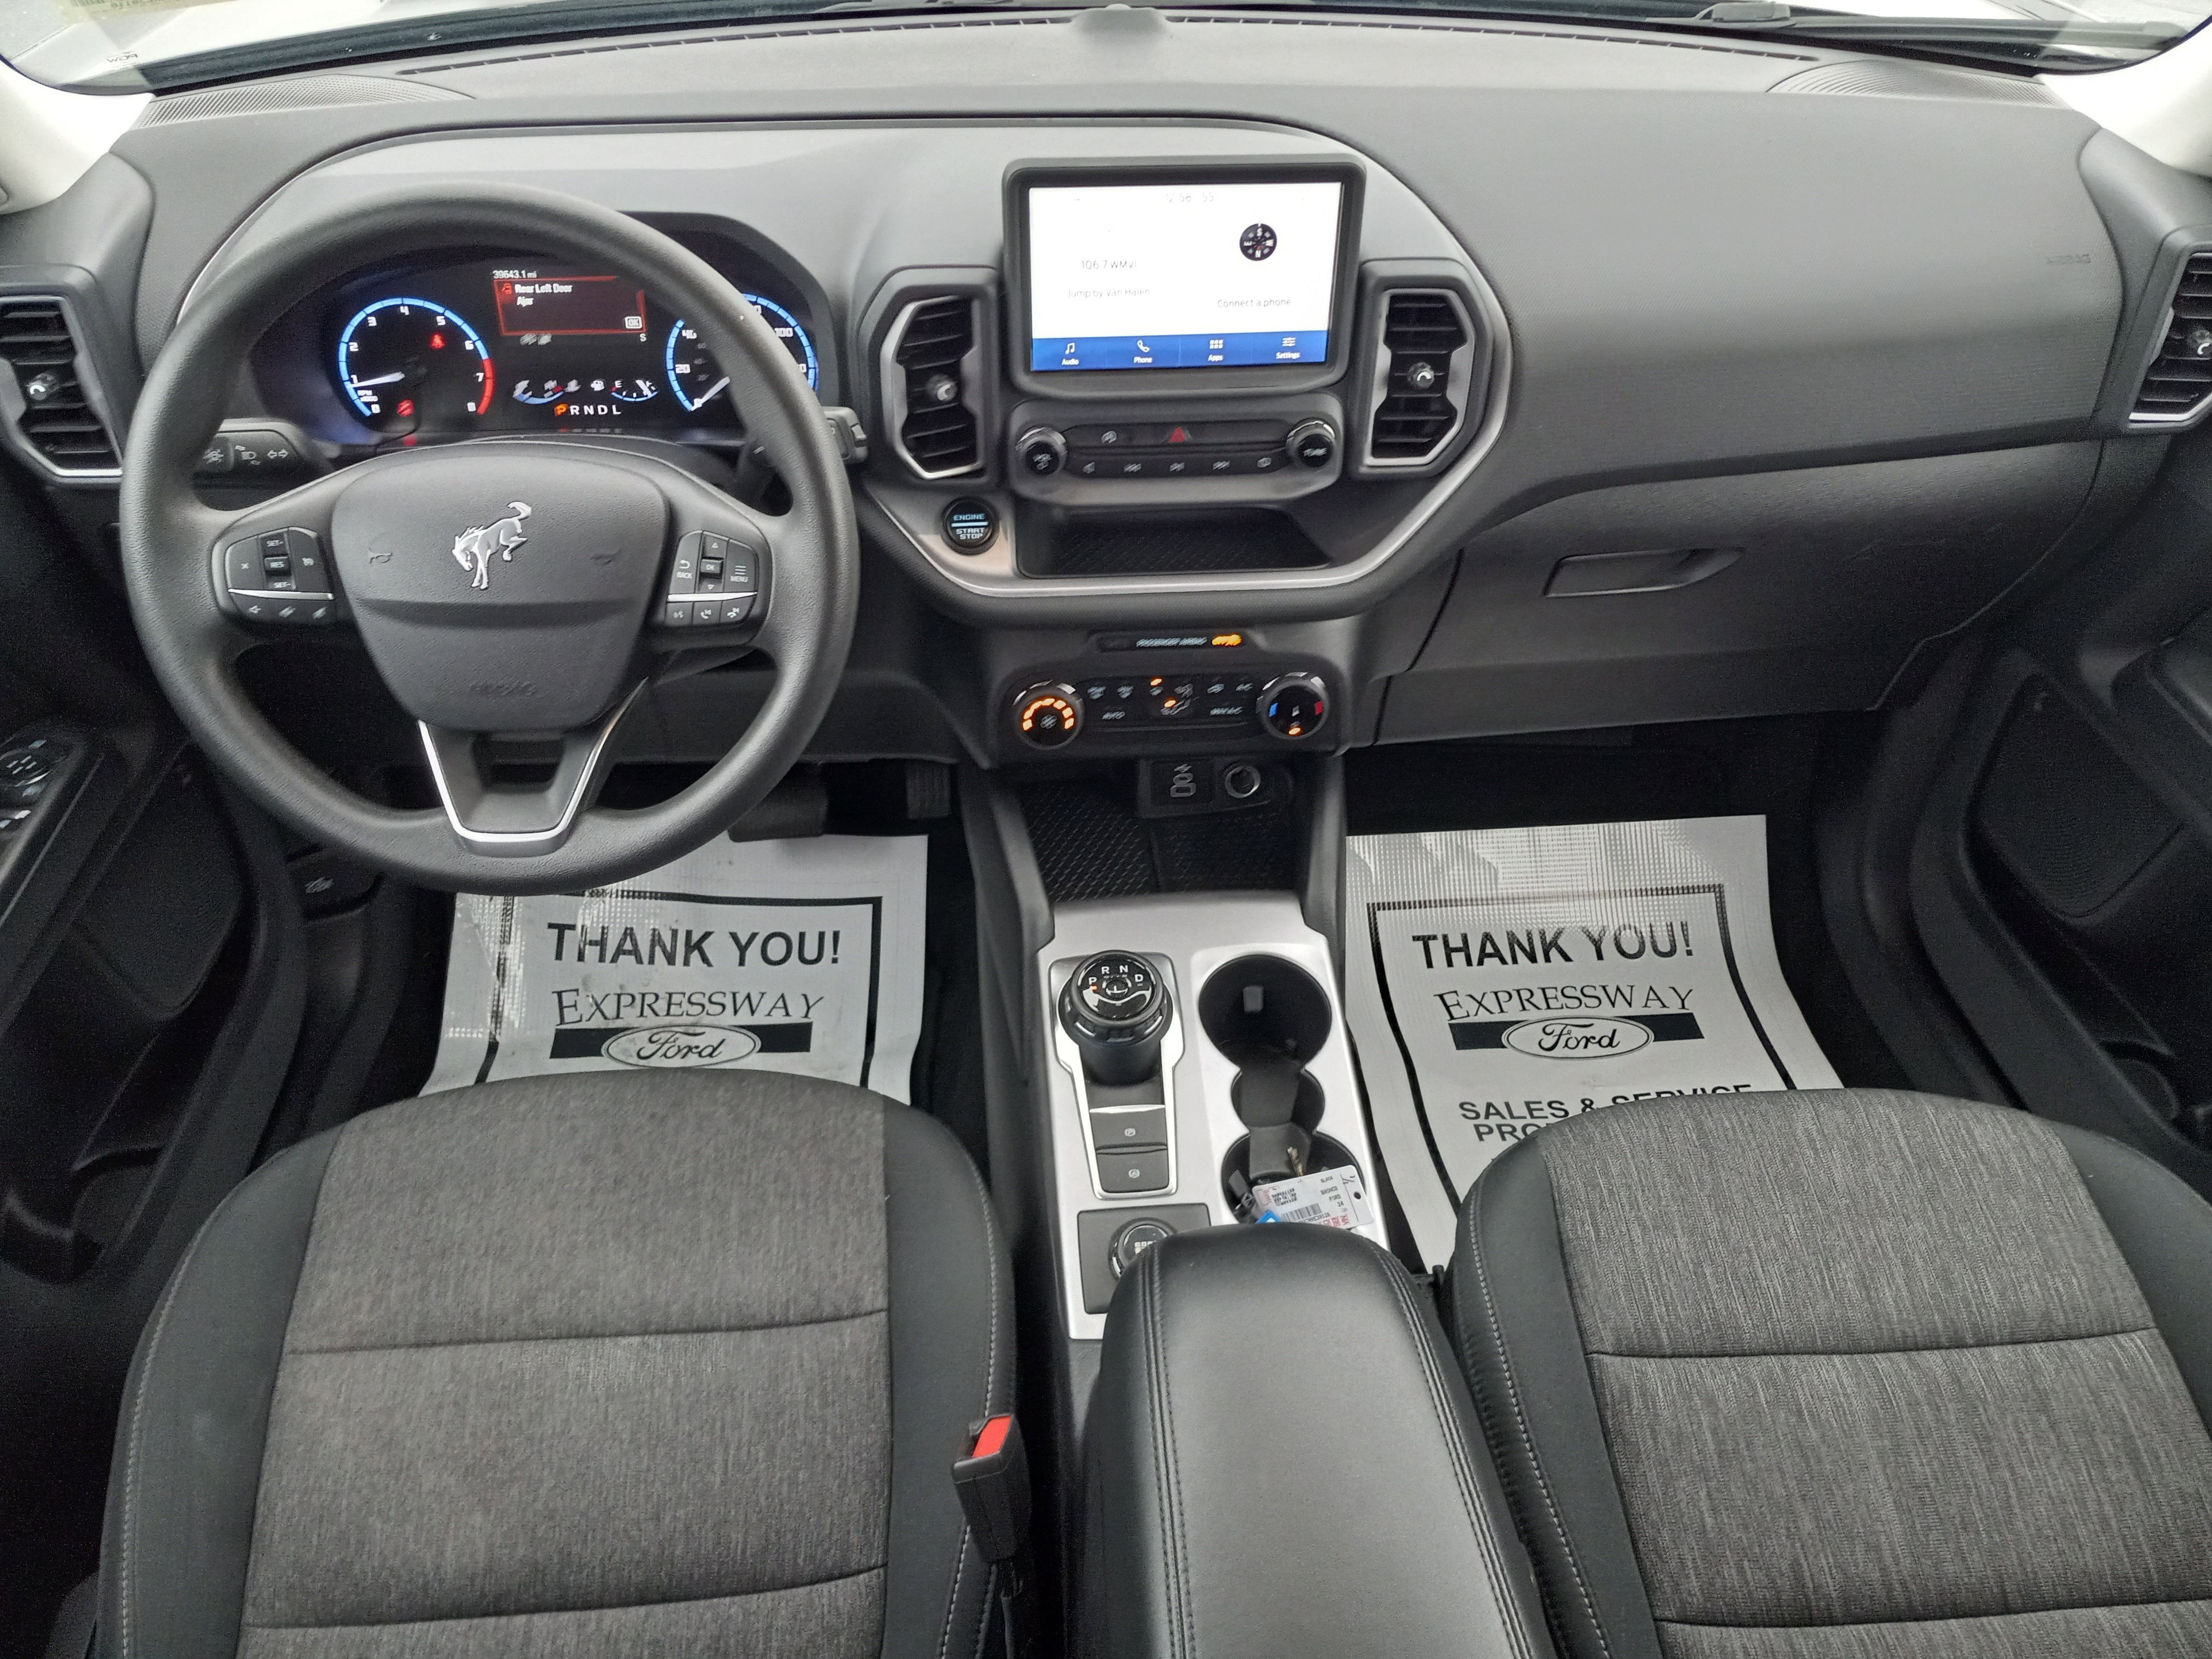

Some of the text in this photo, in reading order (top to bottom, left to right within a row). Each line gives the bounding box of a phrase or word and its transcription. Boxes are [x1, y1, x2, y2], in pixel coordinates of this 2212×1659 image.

[515, 283, 573, 293] Rear Left Door
[1068, 289, 1091, 298] Jump
[1093, 289, 1103, 298] by
[517, 296, 534, 307] Ajar
[1218, 299, 1253, 308] Connect
[1263, 298, 1291, 308] phone
[400, 306, 409, 315] 4
[368, 317, 377, 327] 3
[436, 316, 446, 325] 5
[349, 342, 359, 352] 2
[465, 340, 474, 350] 6
[1133, 356, 1152, 364] Phone
[1208, 354, 1223, 363] Apps
[1275, 351, 1300, 361] Settings
[1062, 357, 1079, 366] Audio
[675, 364, 691, 373] 20
[350, 374, 358, 384] 1
[475, 373, 484, 382] 7
[371, 404, 381, 413] 0
[554, 403, 621, 417] P R N D L
[547, 922, 841, 967] THANK YOU!
[1412, 920, 1695, 969] THANK YOU!
[1102, 966, 1110, 974] R
[1119, 965, 1128, 973] N
[1089, 976, 1097, 985] P
[1135, 974, 1143, 982] D
[552, 988, 825, 1026] EXPRESSWAY
[1434, 984, 1694, 1021] EXPRESSWAY
[1538, 1022, 1621, 1053] Ford
[637, 1030, 727, 1061] Ford
[1458, 1100, 1570, 1120] SALES
